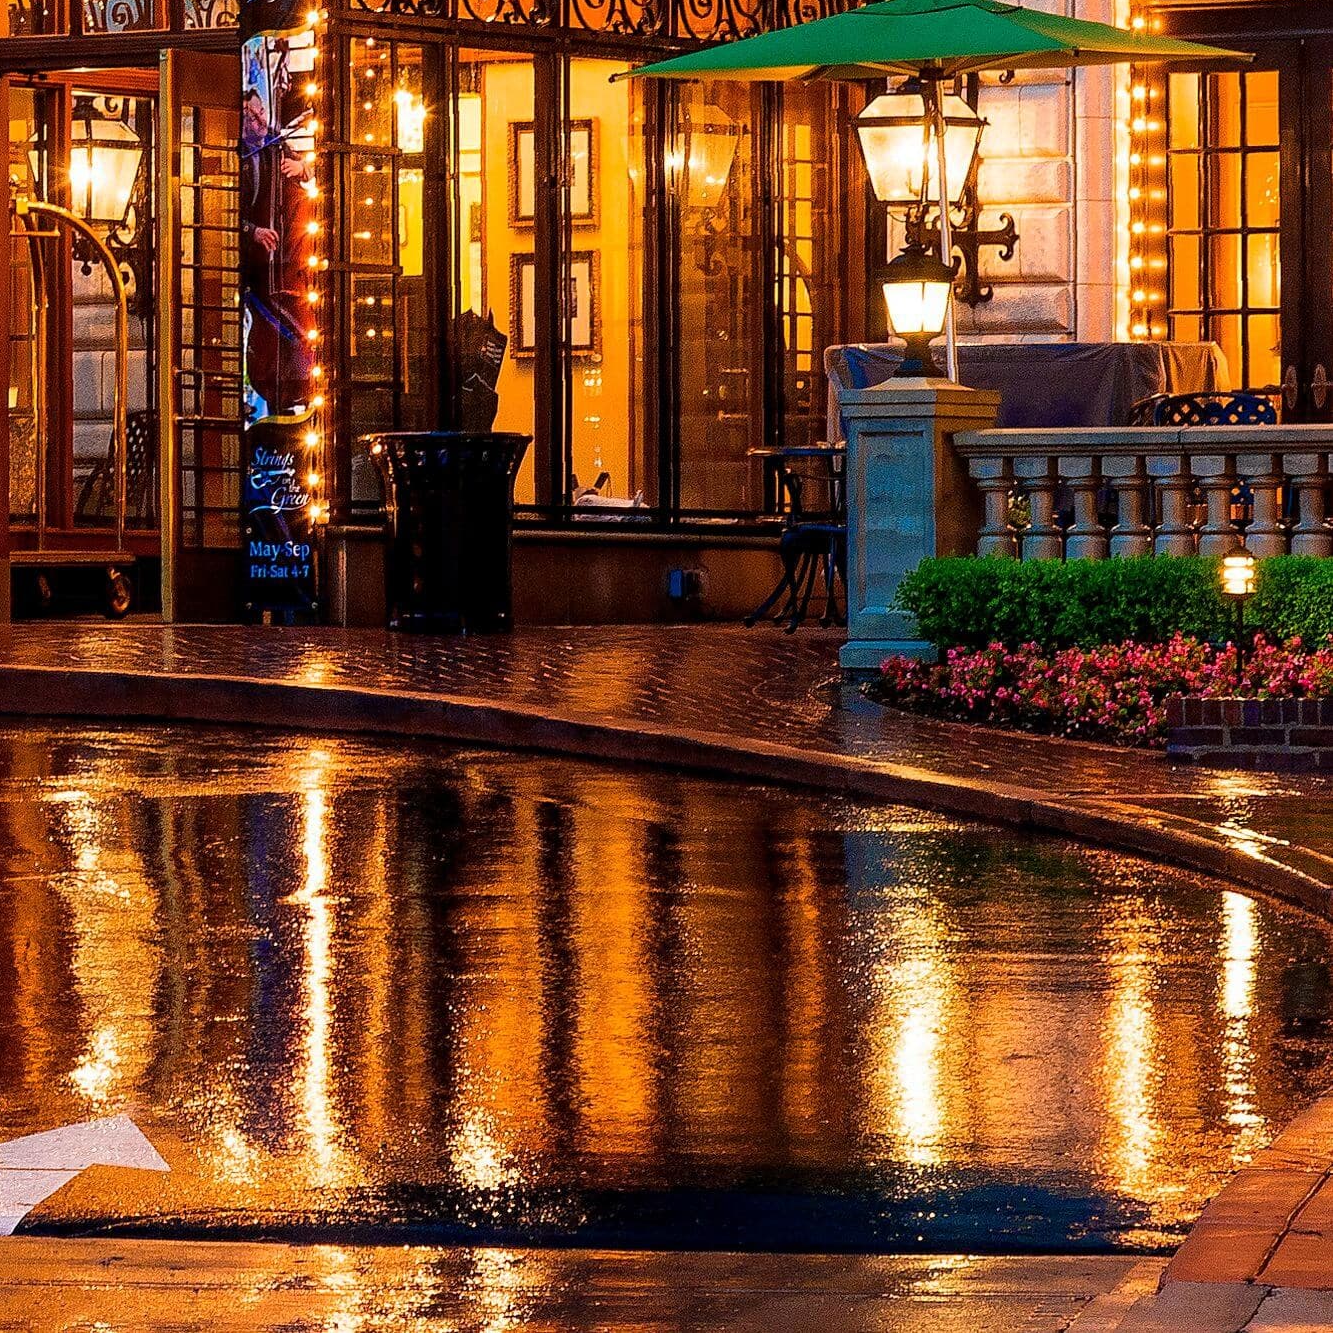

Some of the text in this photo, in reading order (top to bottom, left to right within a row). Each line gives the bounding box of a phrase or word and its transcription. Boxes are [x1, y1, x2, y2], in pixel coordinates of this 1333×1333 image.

[251, 446, 294, 470] Strings
[288, 479, 300, 493] the
[271, 487, 309, 515] Green
[250, 541, 310, 561] May-Sep
[250, 565, 309, 578] Fri-Sat 4-7
